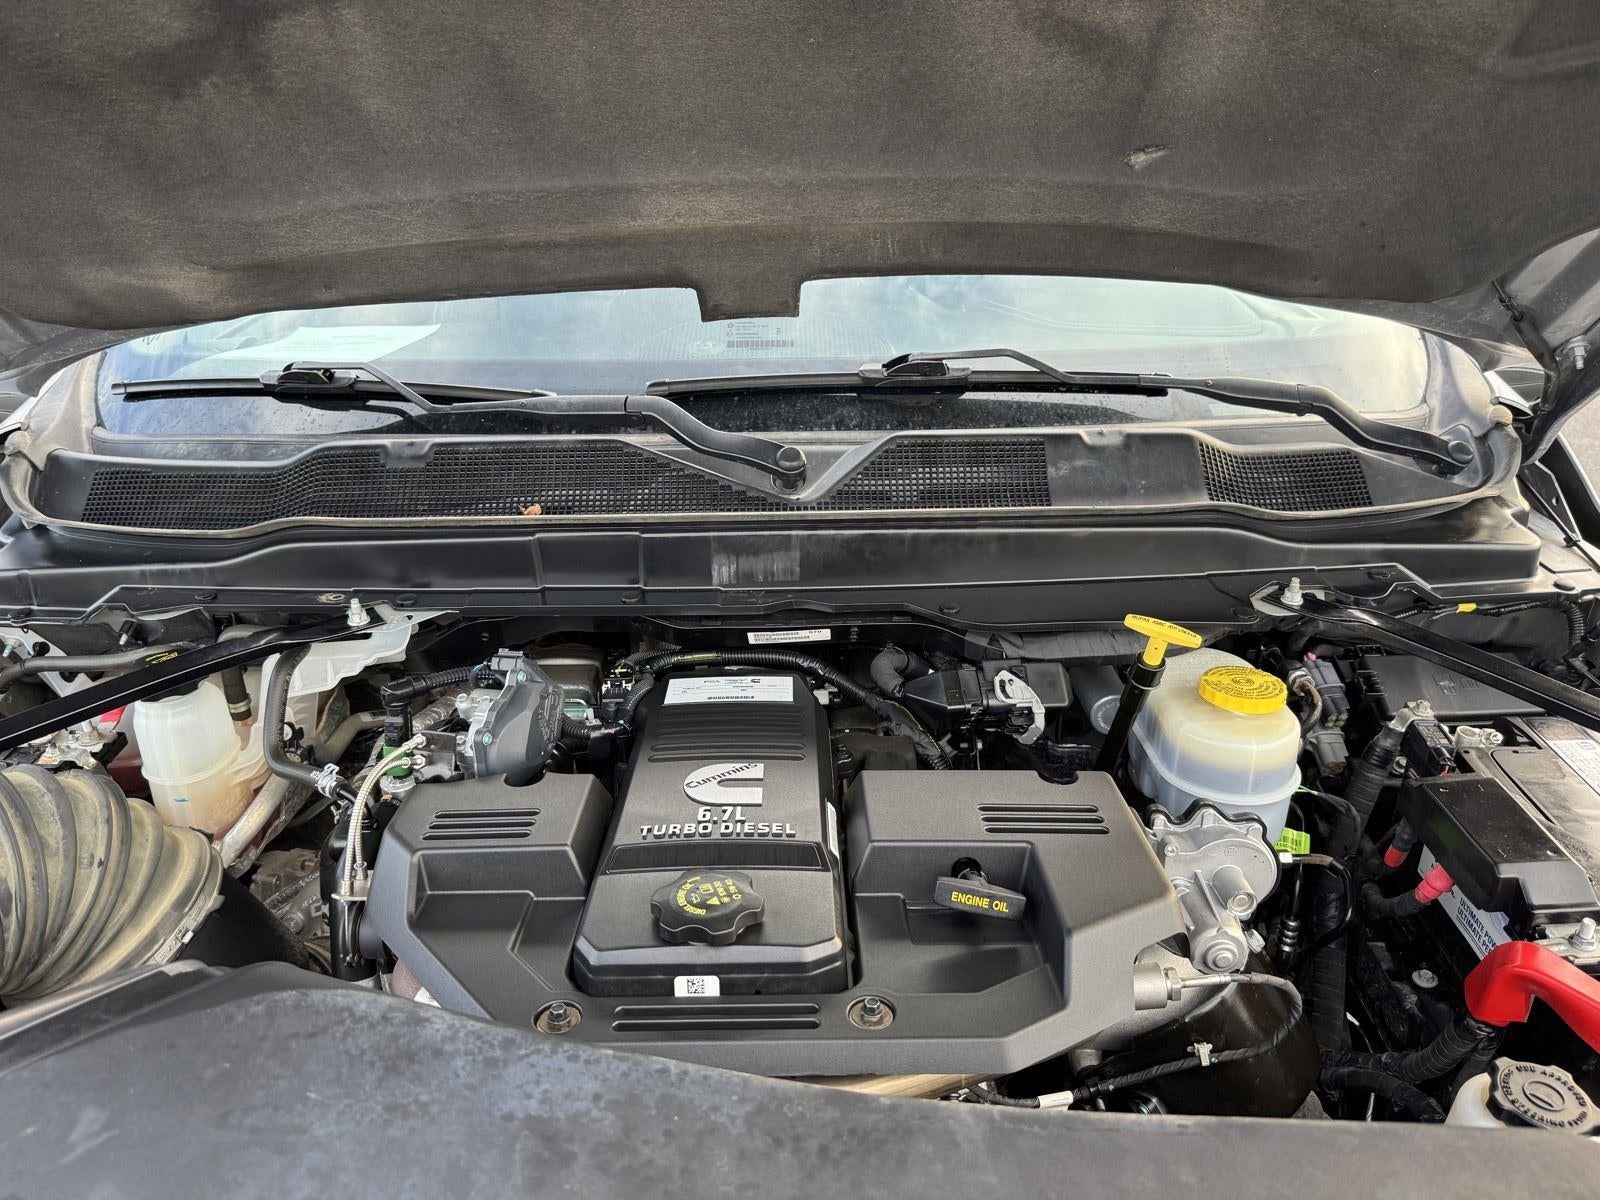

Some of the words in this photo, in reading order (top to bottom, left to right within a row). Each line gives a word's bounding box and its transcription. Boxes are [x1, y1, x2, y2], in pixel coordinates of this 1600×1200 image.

[685, 763, 758, 789] Cummins
[697, 806, 746, 823] 6.7L
[640, 823, 712, 839] TURBO
[720, 822, 796, 837] DIESEL
[951, 891, 990, 909] ENGINE
[992, 900, 1009, 913] OIL
[1457, 906, 1482, 943] ULTIMATE
[1460, 897, 1485, 934] ULTIMATE
